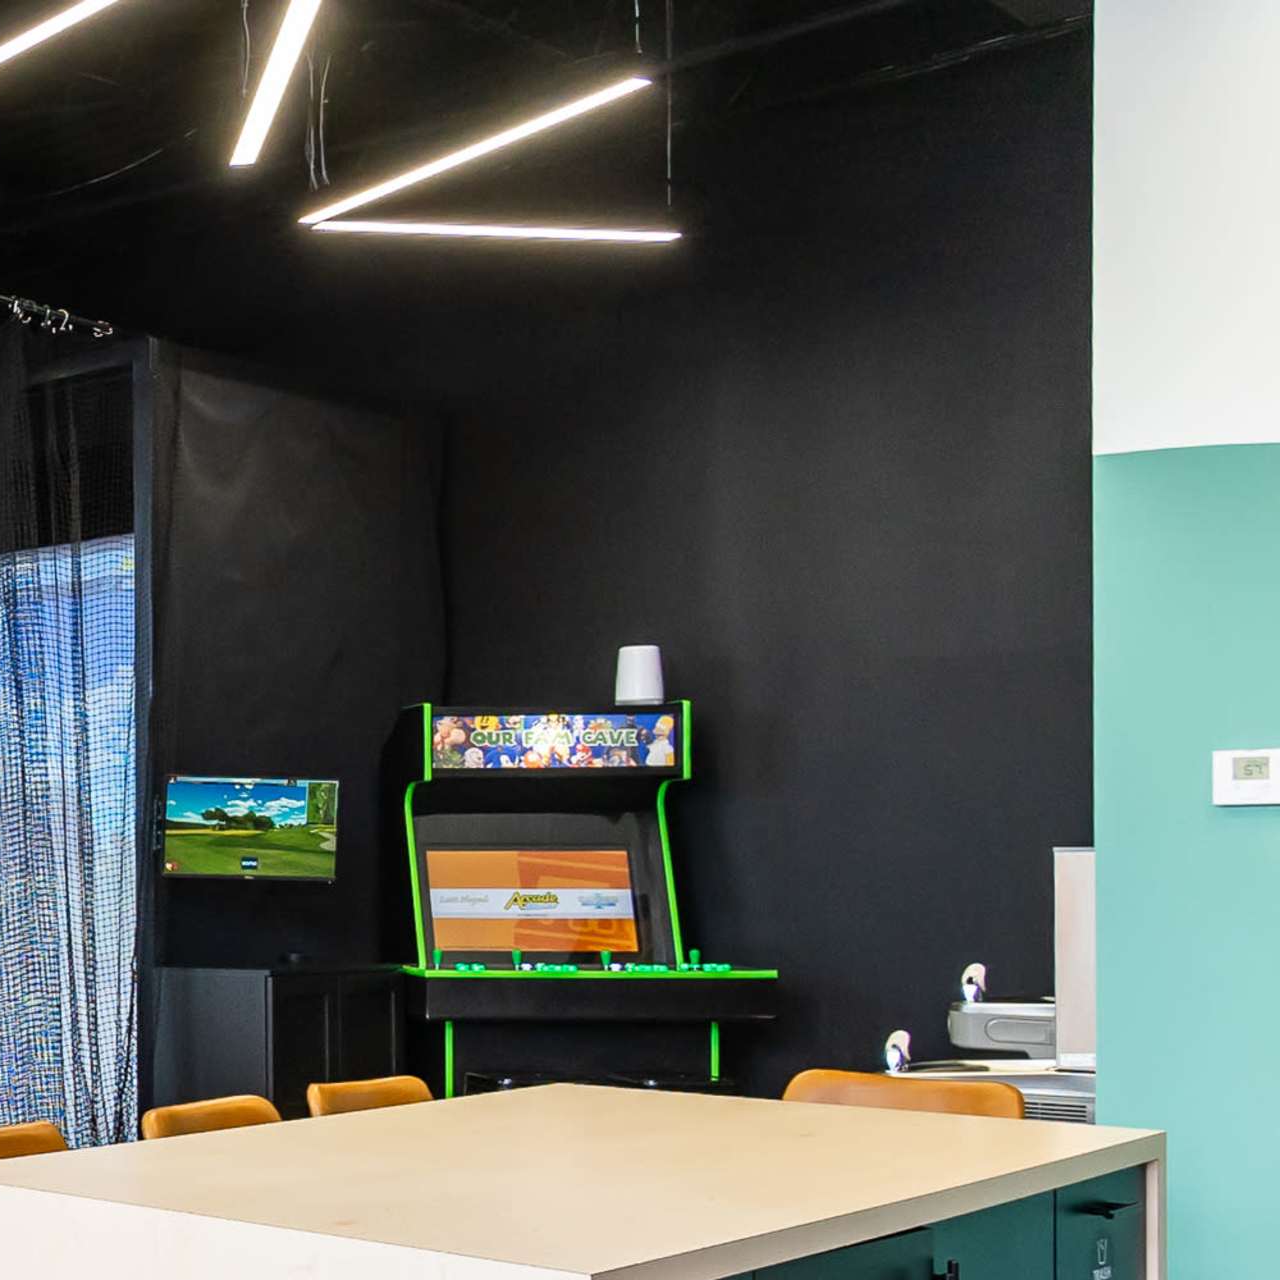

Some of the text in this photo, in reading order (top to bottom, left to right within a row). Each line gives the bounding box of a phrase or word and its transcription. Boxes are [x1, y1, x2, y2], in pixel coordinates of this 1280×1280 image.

[469, 729, 639, 747] OUR FAM CAVE
